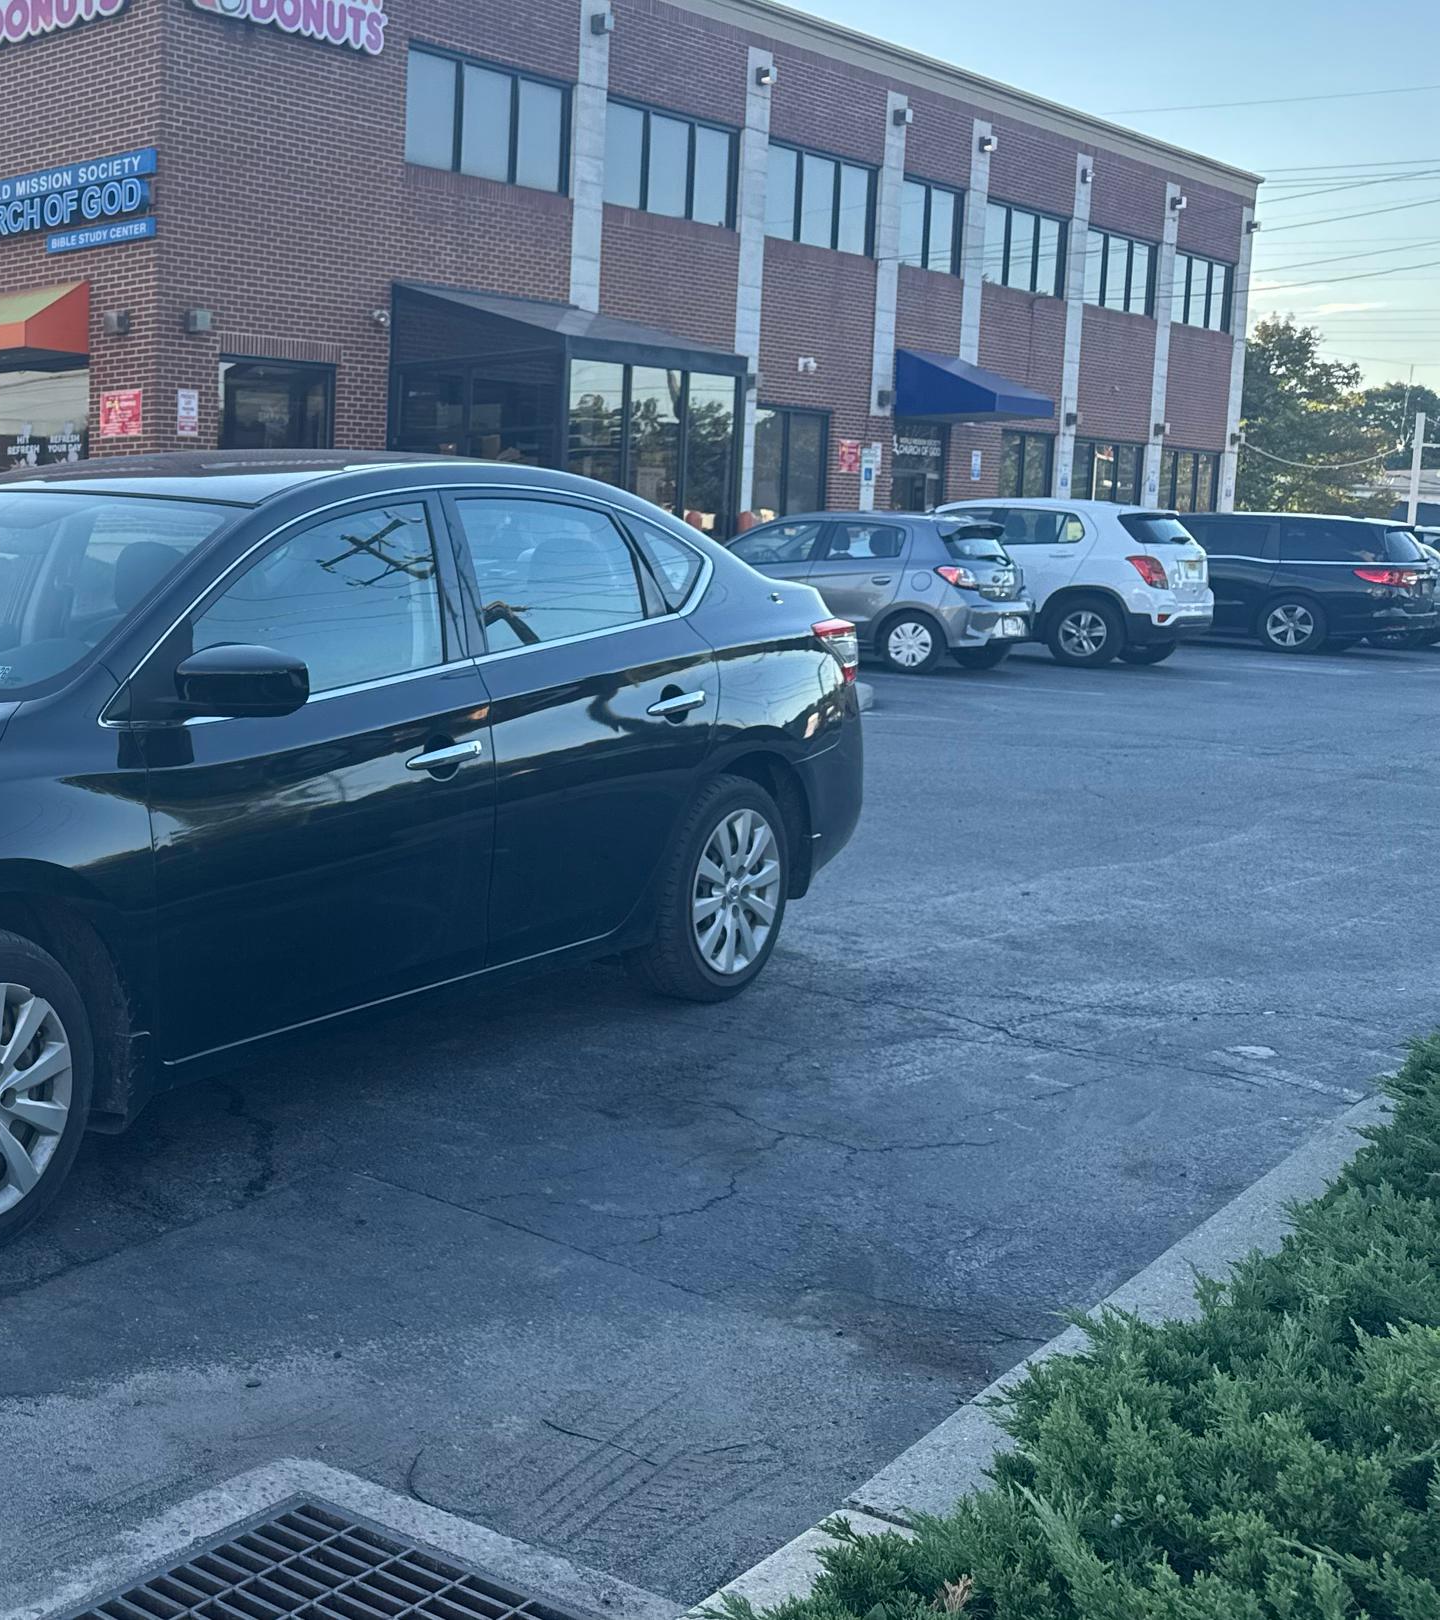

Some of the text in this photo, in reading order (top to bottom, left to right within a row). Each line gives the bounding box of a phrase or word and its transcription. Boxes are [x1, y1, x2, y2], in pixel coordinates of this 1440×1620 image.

[16, 171, 72, 196] MISSION
[78, 155, 142, 183] SOCIETY
[44, 189, 78, 226] OF
[81, 178, 141, 220] GOD
[51, 222, 147, 249] BIBLE STUDY CENTER
[899, 444, 921, 455] CHURCH
[921, 446, 929, 456] OF
